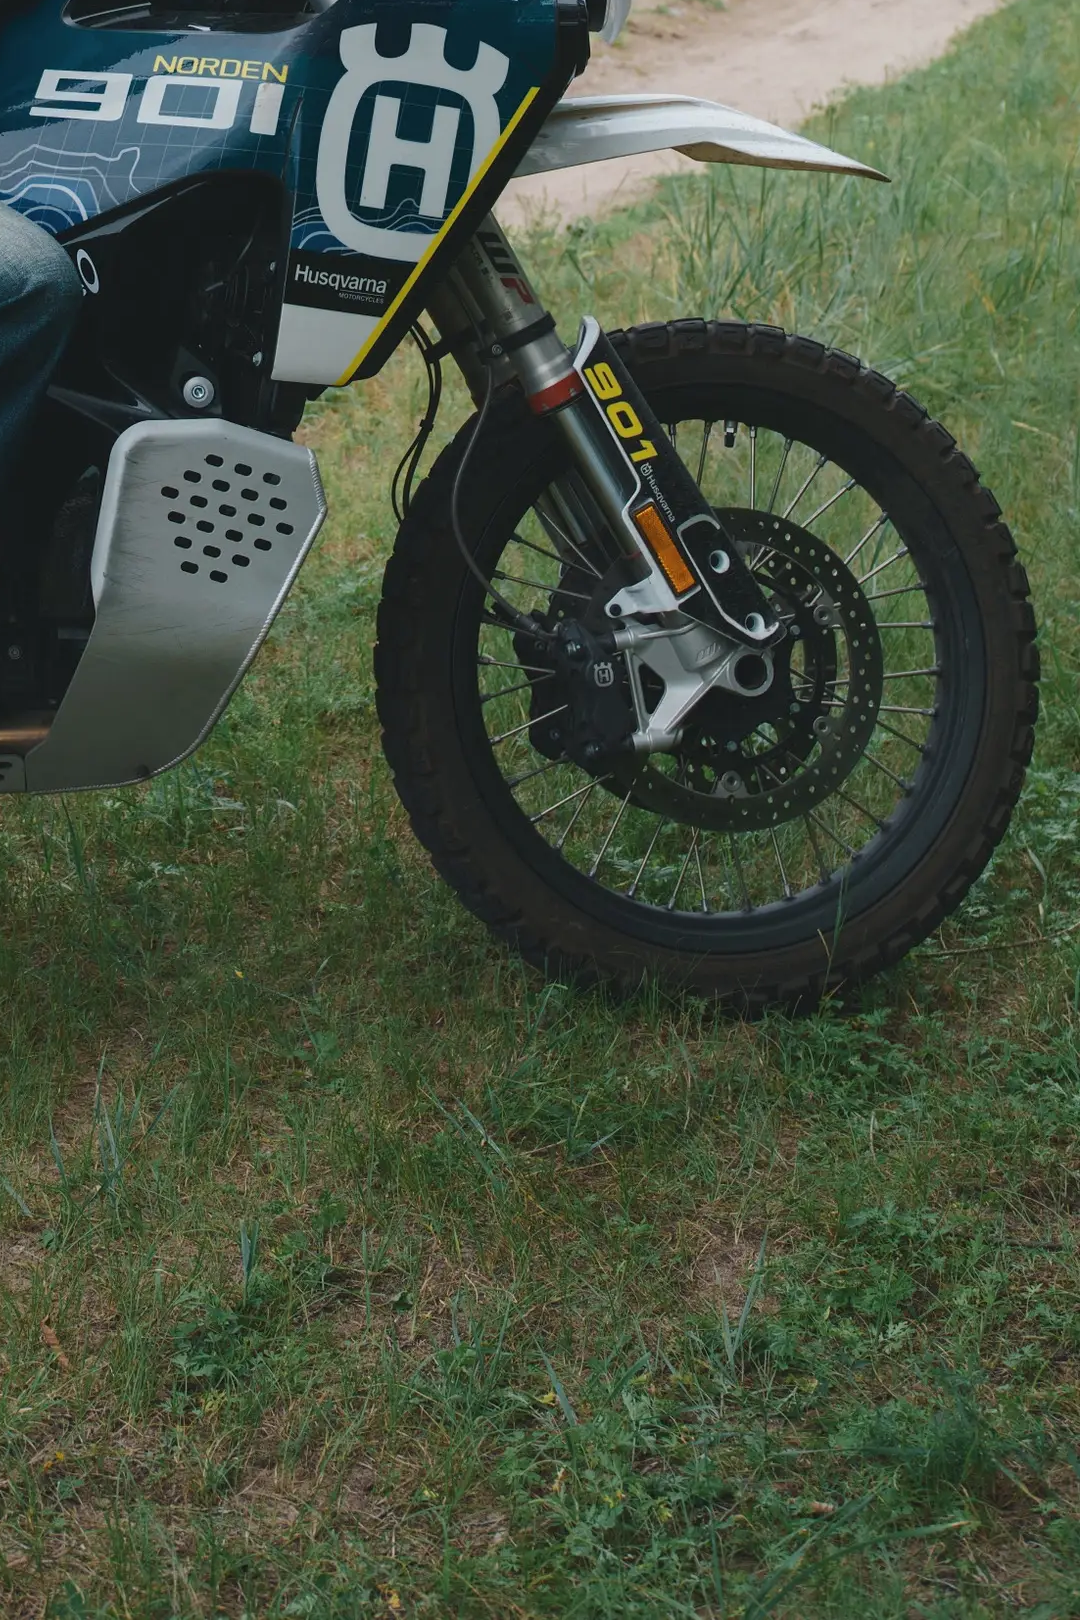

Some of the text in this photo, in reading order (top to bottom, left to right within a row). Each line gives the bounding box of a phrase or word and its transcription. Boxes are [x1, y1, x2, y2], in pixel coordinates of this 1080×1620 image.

[153, 54, 288, 83] NORDEN
[29, 69, 285, 136] 901
[295, 264, 388, 294] Husqvarna
[338, 292, 385, 305] MOTORCYCLES
[584, 362, 658, 462] 901
[647, 474, 676, 523] Husqvarna
